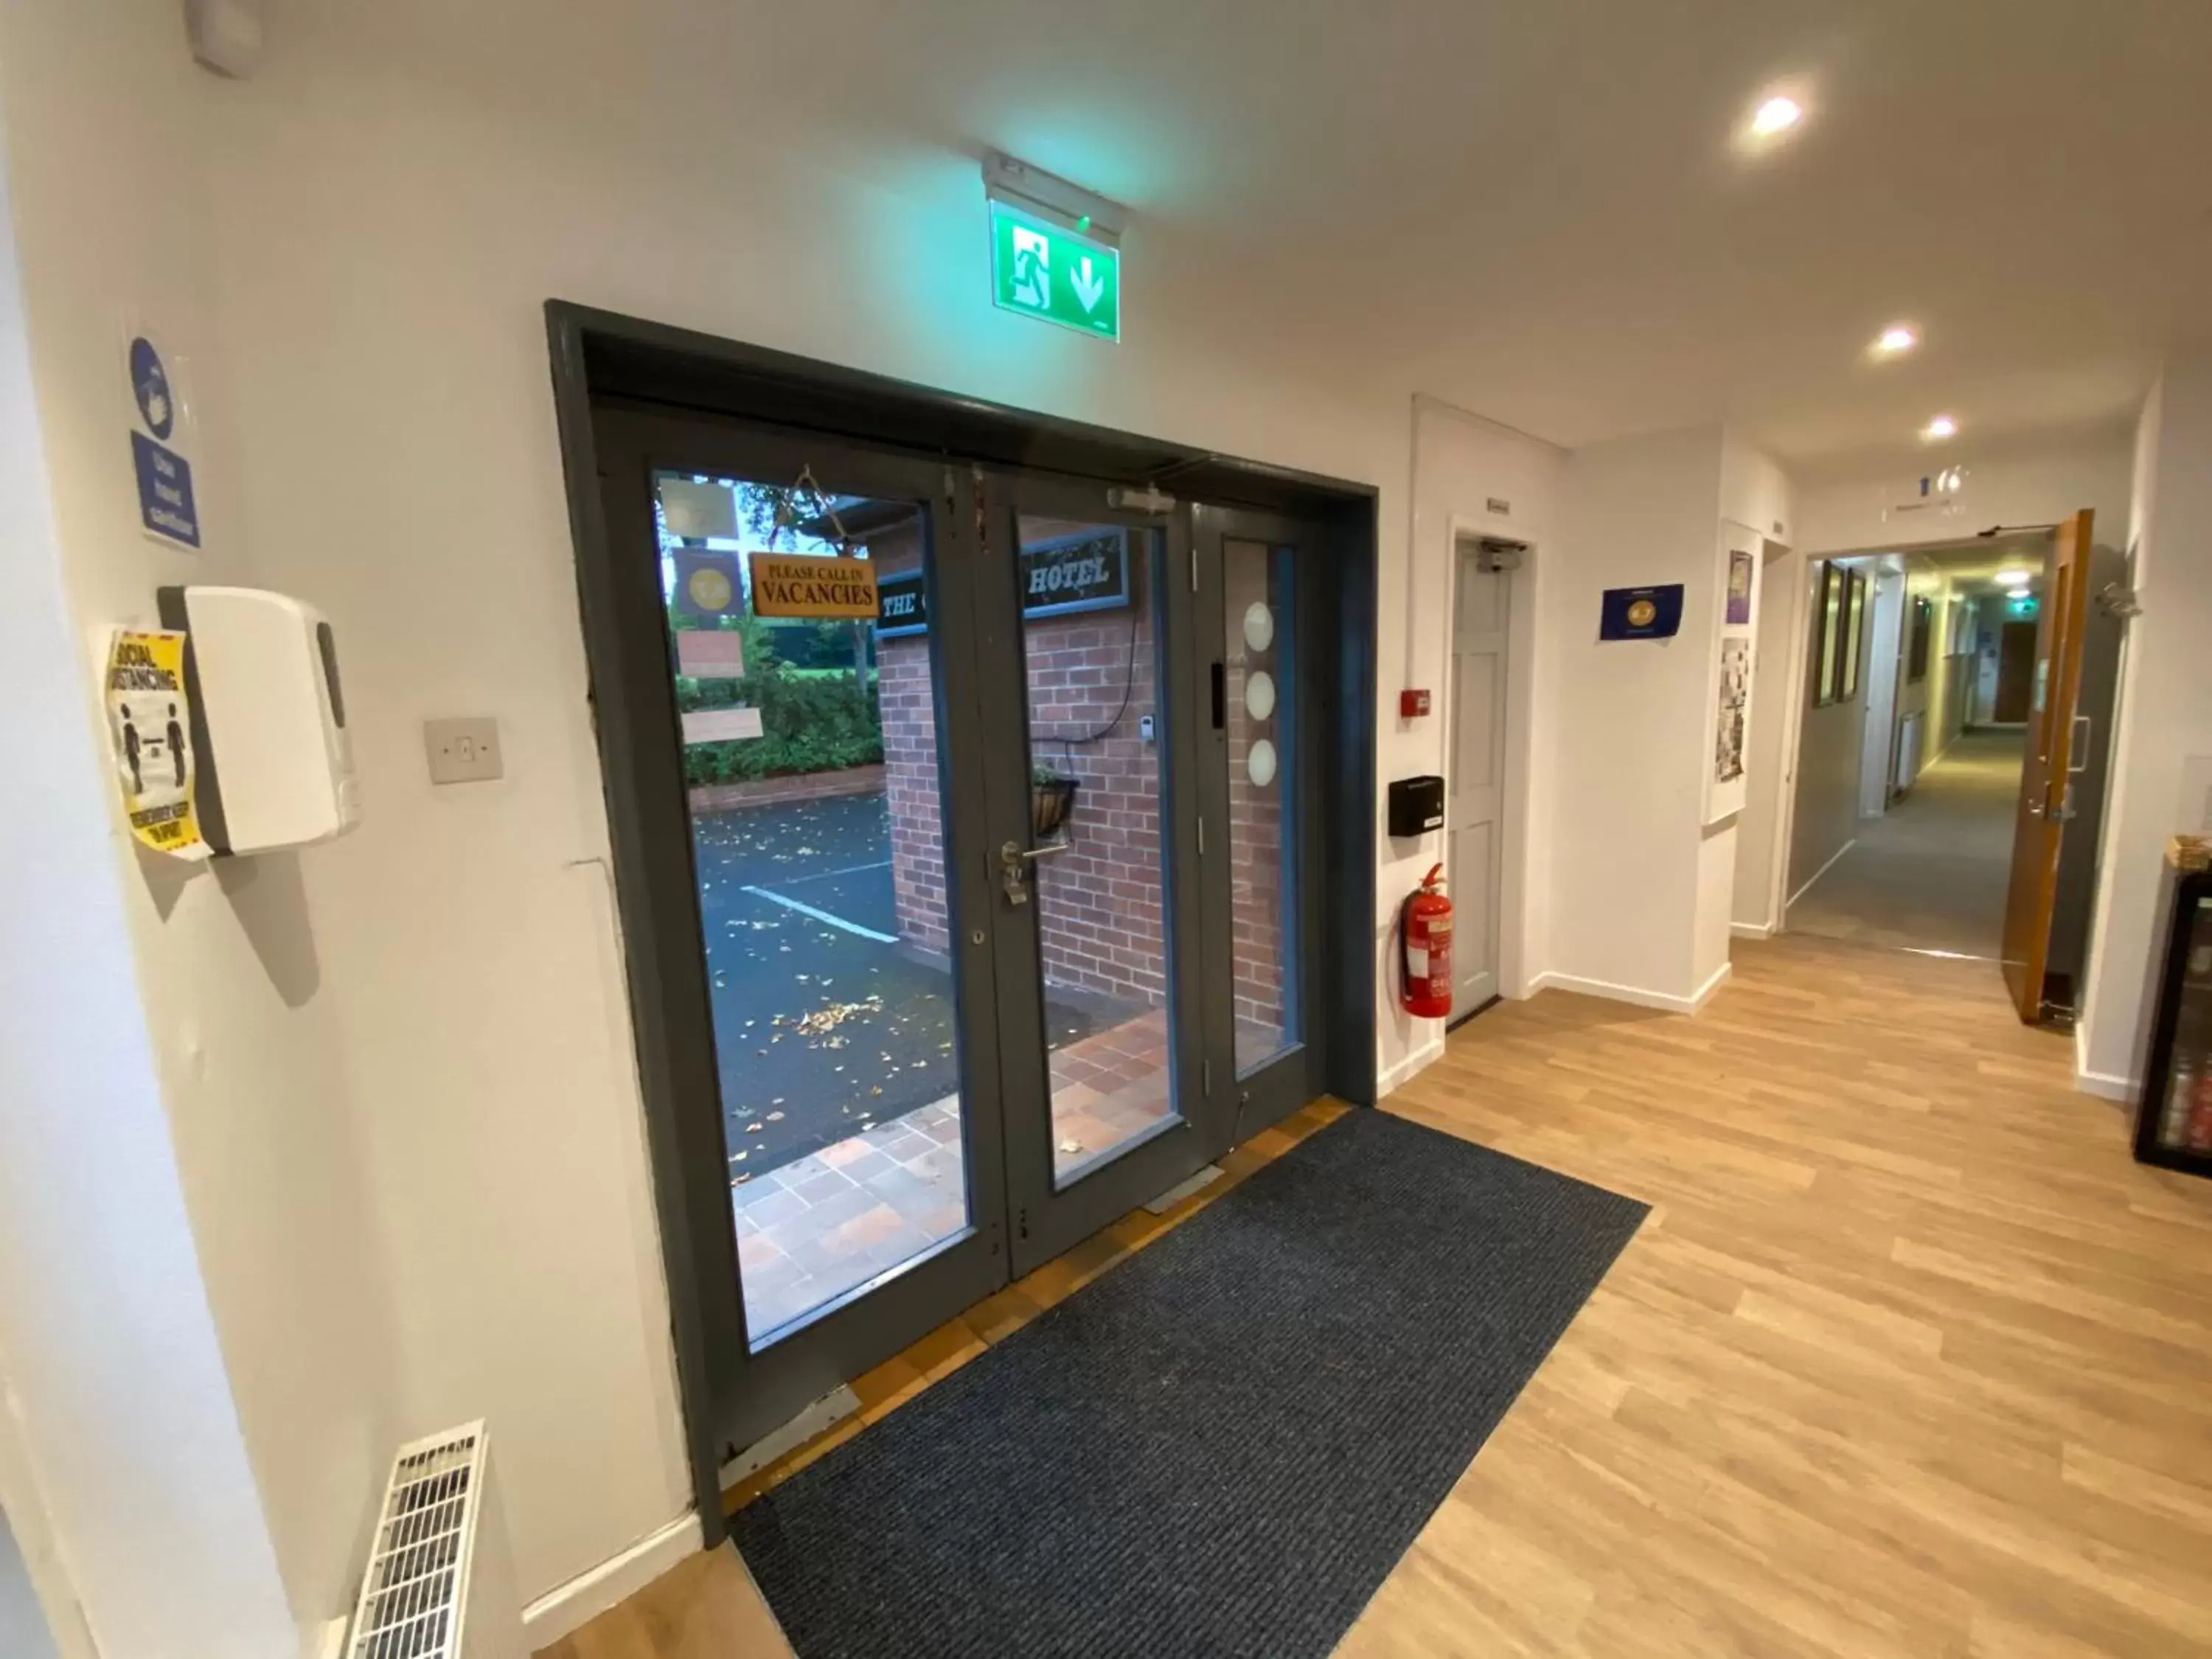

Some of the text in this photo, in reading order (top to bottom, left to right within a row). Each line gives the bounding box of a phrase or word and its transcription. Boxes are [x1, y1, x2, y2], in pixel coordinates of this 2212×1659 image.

[768, 564, 863, 581] PLEASE CALL IN
[761, 580, 873, 606] VACANCIES
[883, 593, 916, 617] THE
[1029, 556, 1110, 594] HOTEL
